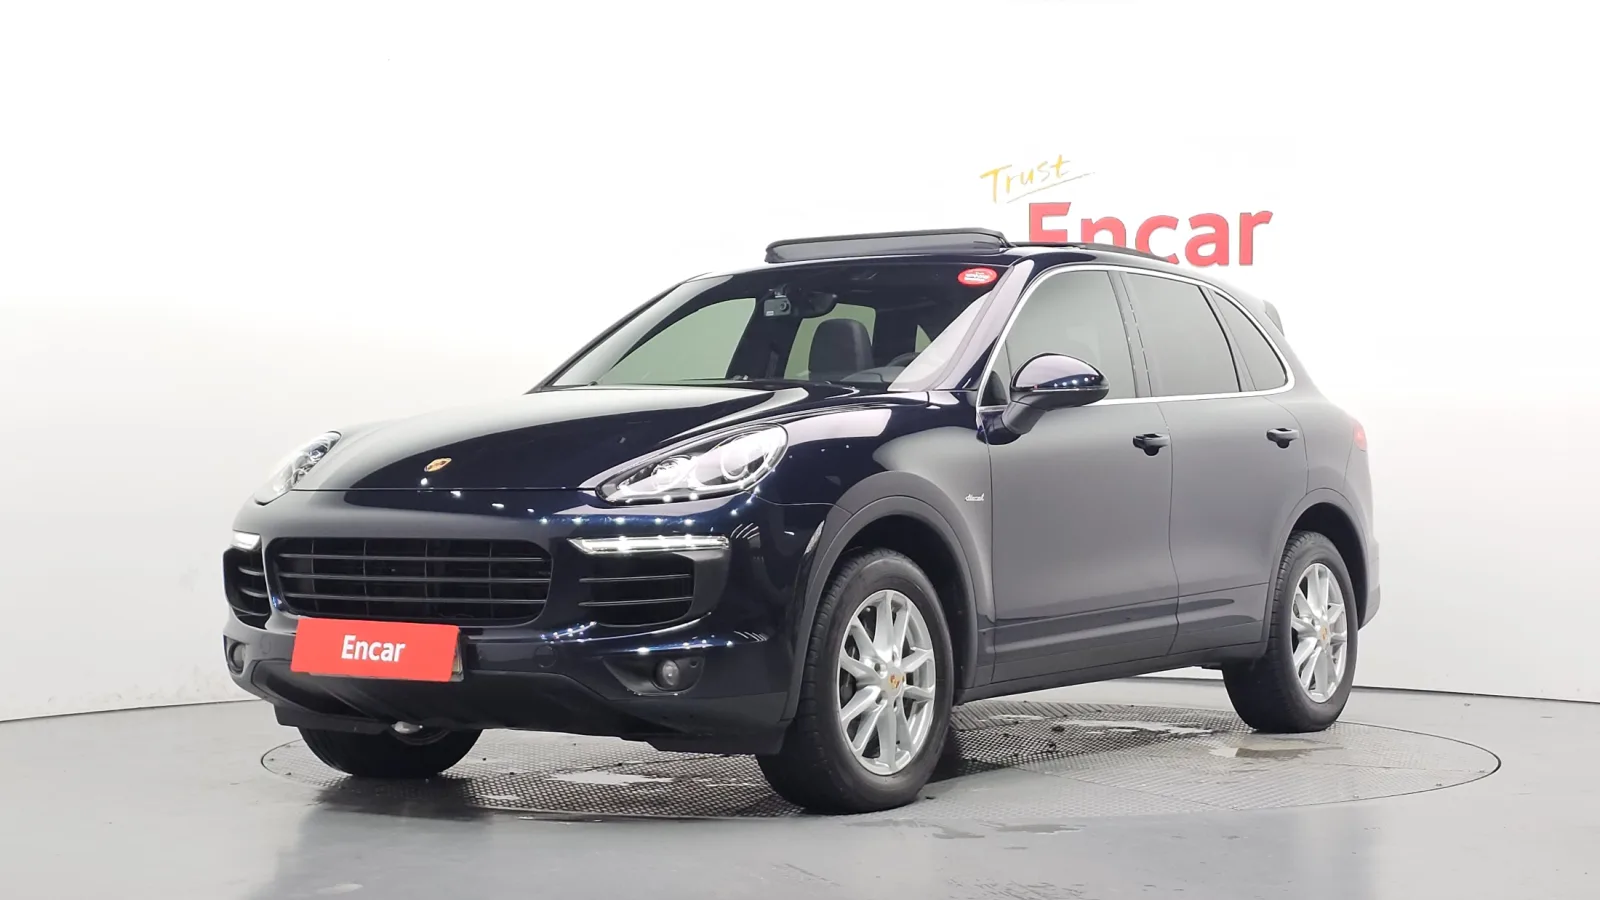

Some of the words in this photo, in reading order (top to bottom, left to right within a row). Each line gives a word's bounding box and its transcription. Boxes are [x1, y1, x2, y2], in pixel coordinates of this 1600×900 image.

[980, 154, 1071, 203] Trust
[1028, 201, 1273, 267] Encar
[341, 634, 406, 663] Encar
